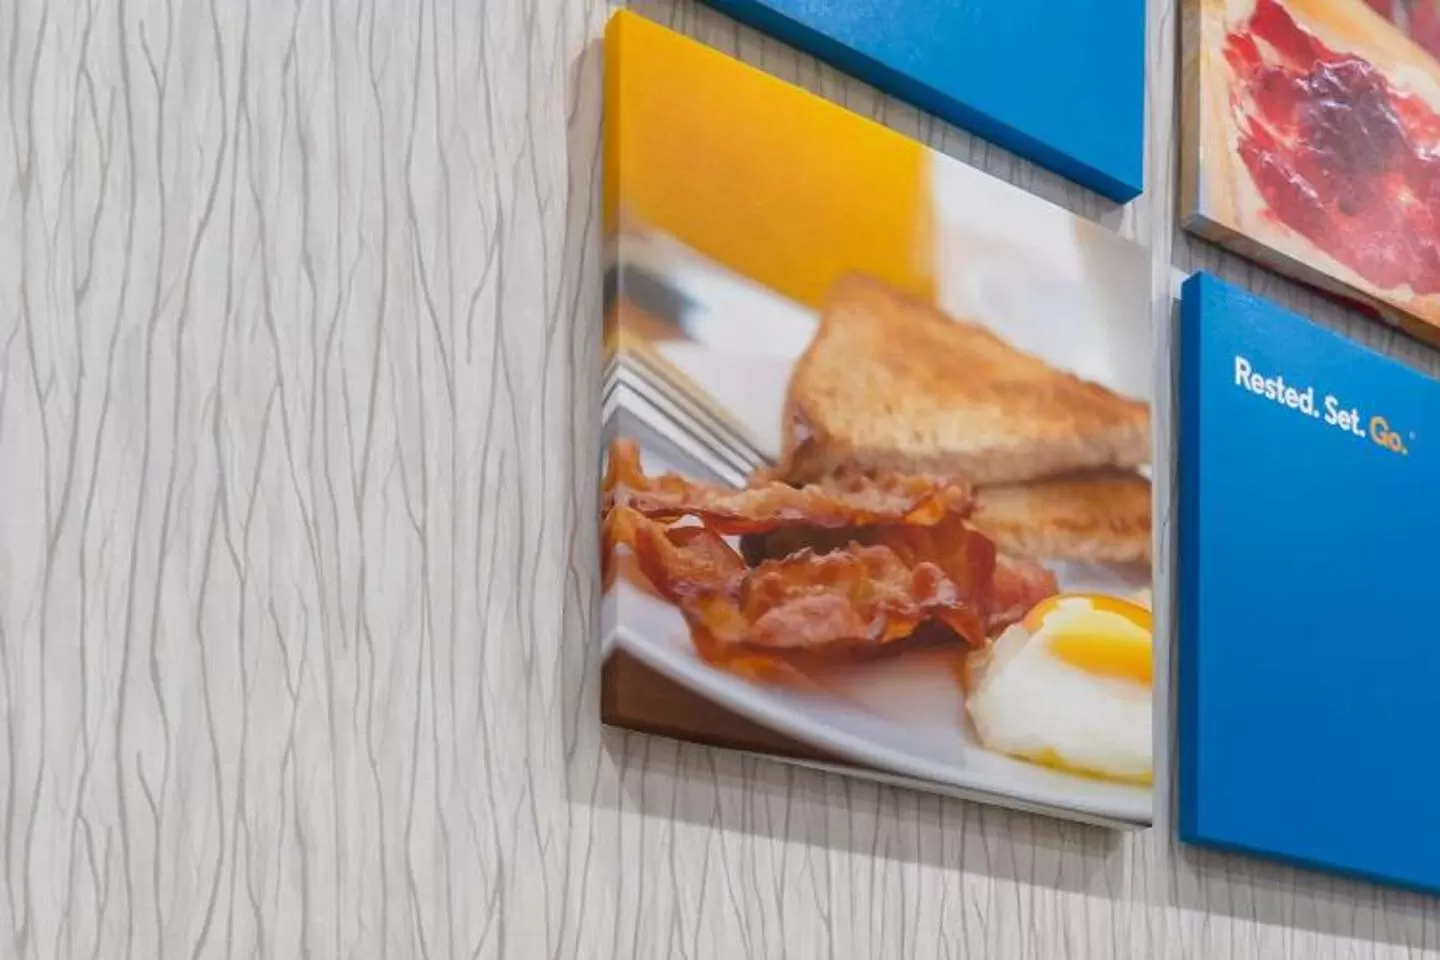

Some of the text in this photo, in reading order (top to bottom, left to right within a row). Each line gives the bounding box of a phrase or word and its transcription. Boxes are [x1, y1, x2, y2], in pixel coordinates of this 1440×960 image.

[1234, 355, 1408, 455] Rested. Set. Go.
